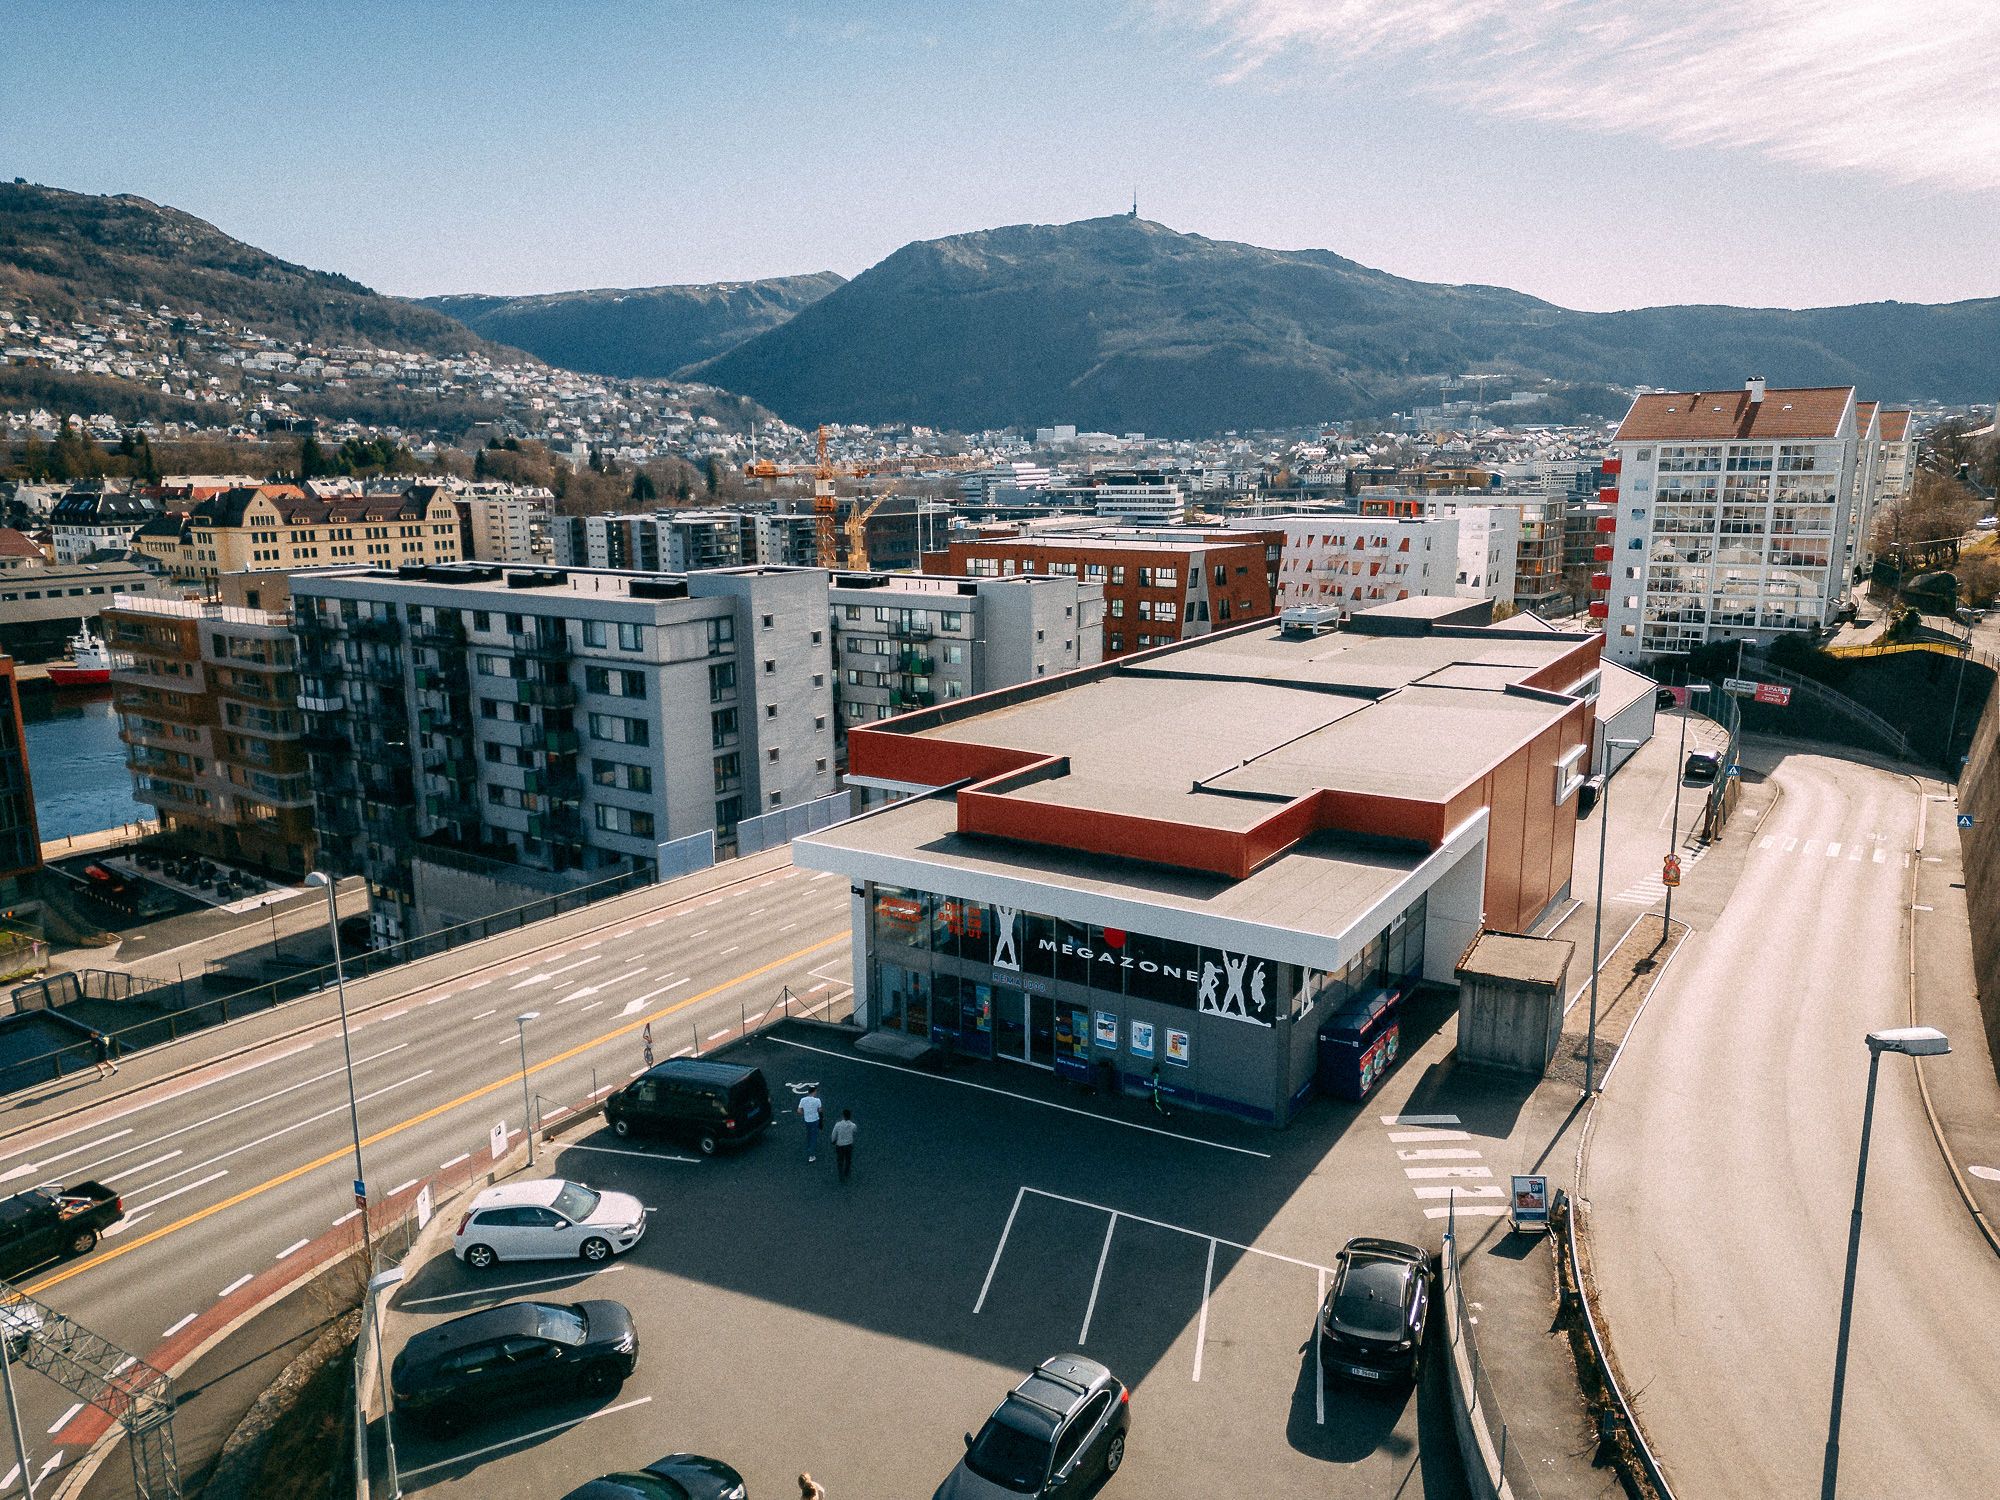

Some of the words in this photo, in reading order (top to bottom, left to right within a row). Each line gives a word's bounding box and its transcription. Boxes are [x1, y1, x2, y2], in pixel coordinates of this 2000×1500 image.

[1038, 939, 1198, 982] MEGAZONE
[992, 972, 1022, 986] REMA
[1023, 978, 1047, 993] 1000
